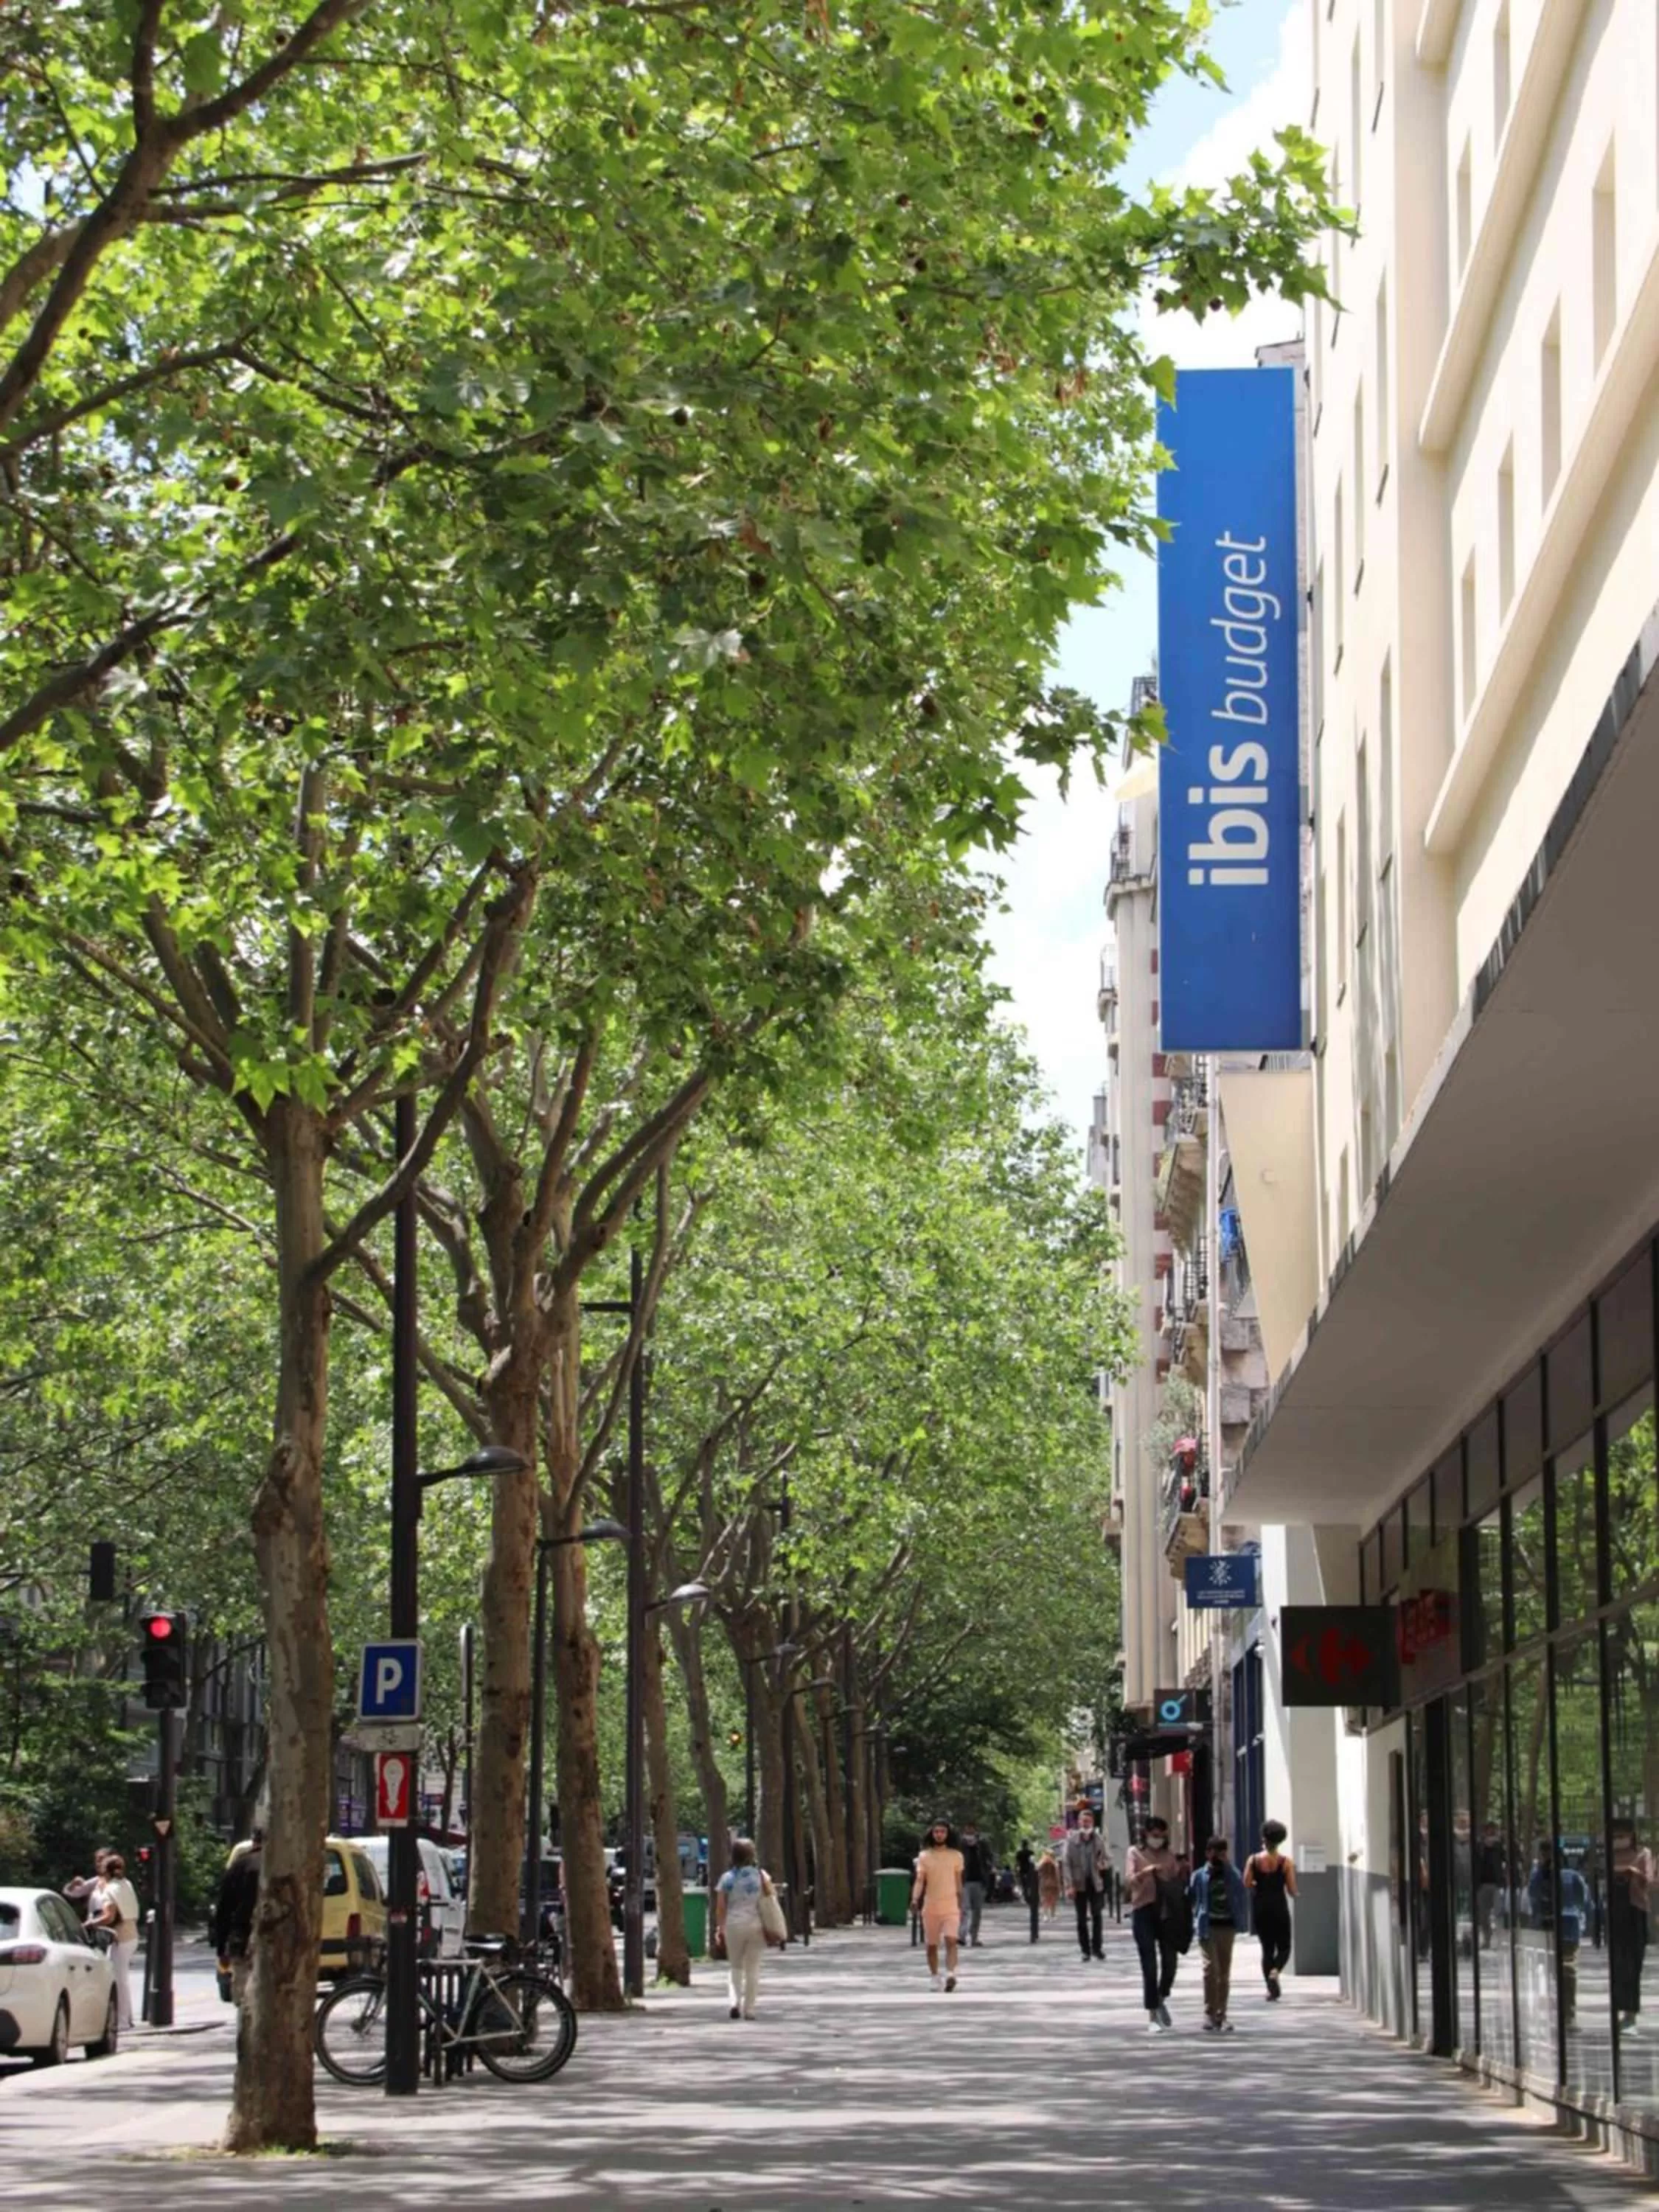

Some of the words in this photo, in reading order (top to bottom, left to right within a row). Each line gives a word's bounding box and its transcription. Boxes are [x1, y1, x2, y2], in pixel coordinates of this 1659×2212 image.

[1210, 530, 1281, 726] budget
[1188, 741, 1269, 885] ibis
[376, 1657, 403, 1705] P
